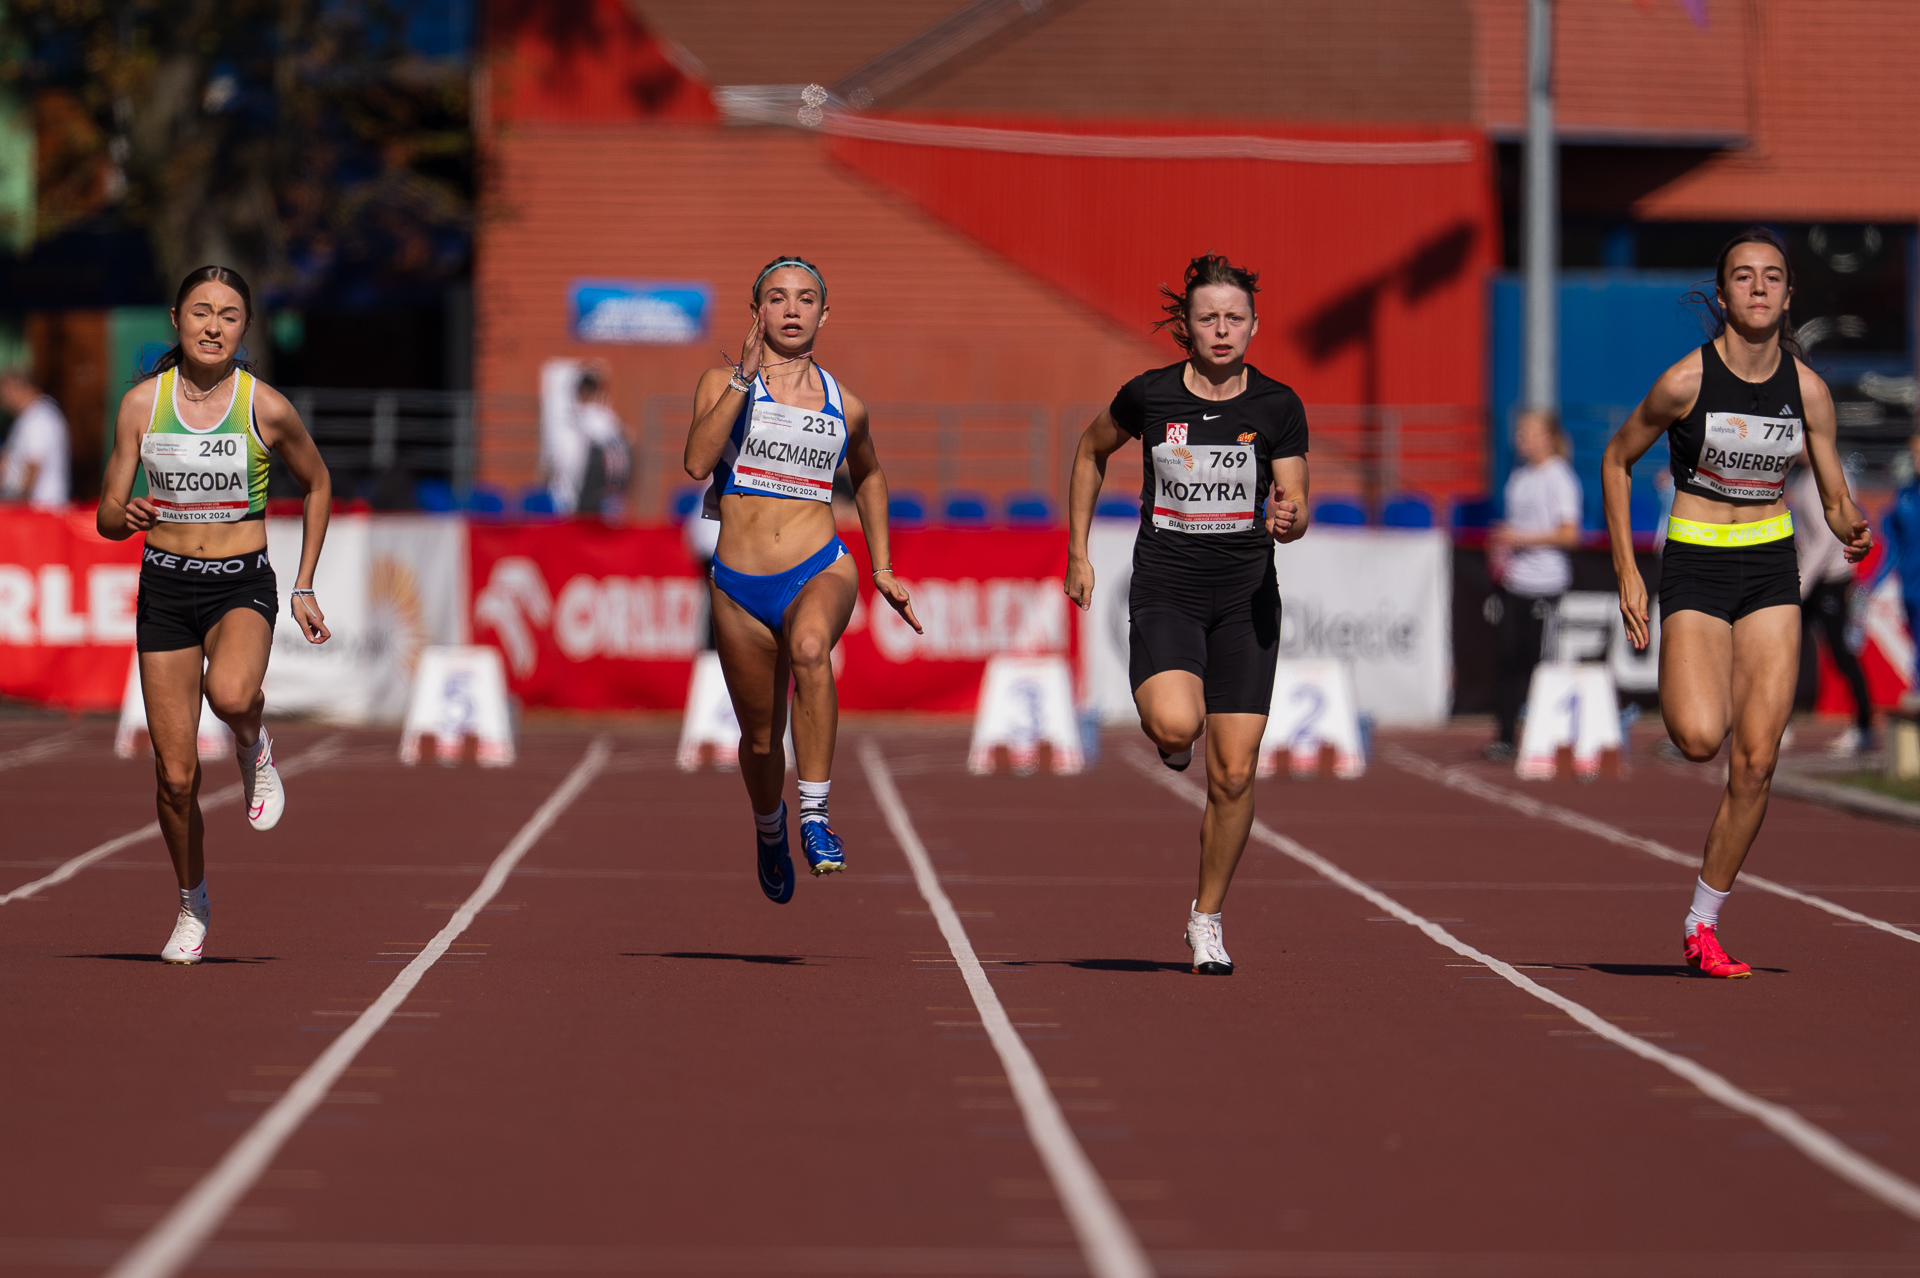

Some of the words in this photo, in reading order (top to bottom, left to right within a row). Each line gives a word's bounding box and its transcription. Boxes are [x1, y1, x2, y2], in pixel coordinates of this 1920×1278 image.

[802, 416, 836, 437] 231
[1763, 422, 1794, 441] 774
[199, 439, 237, 458] 240
[745, 437, 836, 471] KACZMAREK
[1209, 451, 1248, 469] 769
[148, 469, 243, 492] NIEZGODA
[751, 479, 799, 494] BIAŁYSTOK
[799, 488, 818, 496] 2024
[1161, 478, 1247, 502] KOZYRA
[1709, 481, 1755, 496] BIAŁYSTOK
[162, 511, 207, 520] BIAŁYSTOK
[1168, 520, 1214, 531] BIAŁYSTOK
[1669, 522, 1718, 541] PRO
[1727, 521, 1780, 543] NIKE
[182, 558, 245, 575] PRO
[0, 563, 141, 648] RLE
[1289, 683, 1327, 745] 2
[1556, 687, 1584, 743] 1
